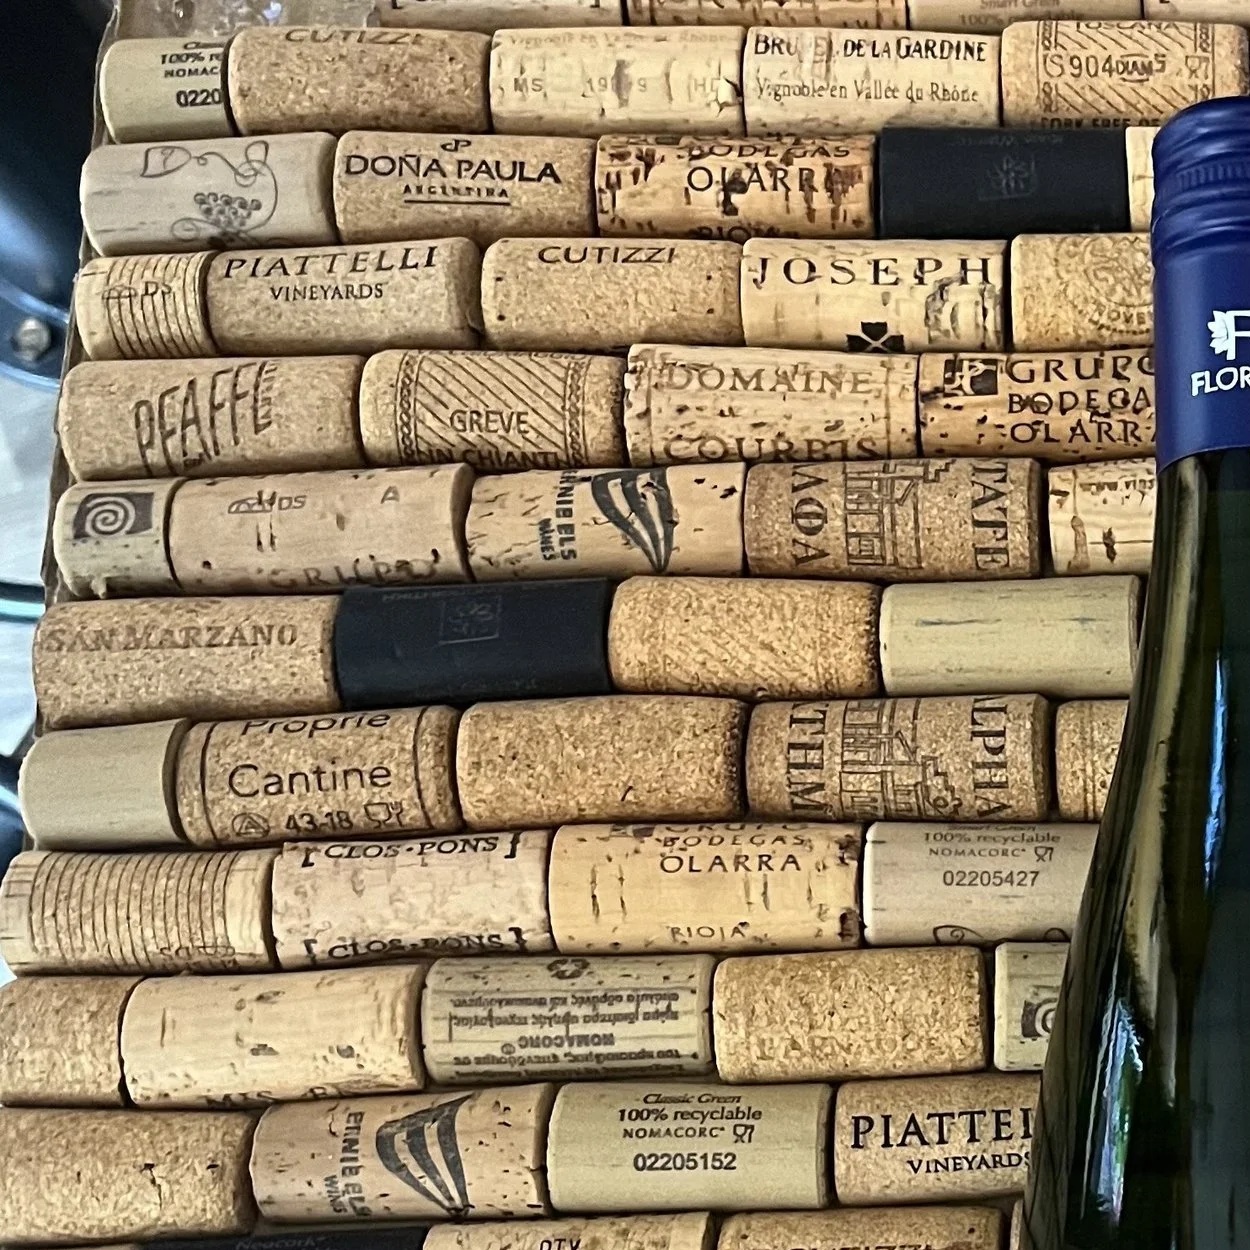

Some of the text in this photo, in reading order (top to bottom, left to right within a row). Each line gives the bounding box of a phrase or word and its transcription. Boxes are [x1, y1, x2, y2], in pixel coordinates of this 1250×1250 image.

[896, 37, 987, 62] GARDINE
[345, 154, 561, 184] DOÑA PAULA
[224, 245, 437, 279] PIATTELLI
[537, 245, 675, 265] CUTIZZI
[752, 257, 991, 287] JOSEPH
[270, 283, 383, 303] VINEYARDS
[665, 368, 873, 395] DOMAINE
[449, 410, 529, 434] GREVE
[1012, 420, 1156, 445] OLARR
[228, 761, 393, 799] Cantine
[924, 831, 1061, 846] 100% recyclable
[659, 852, 803, 874] OLARRA
[942, 869, 1040, 888] 02205427
[616, 1105, 763, 1123] 100% recyclable
[632, 1152, 737, 1172] 02205152
